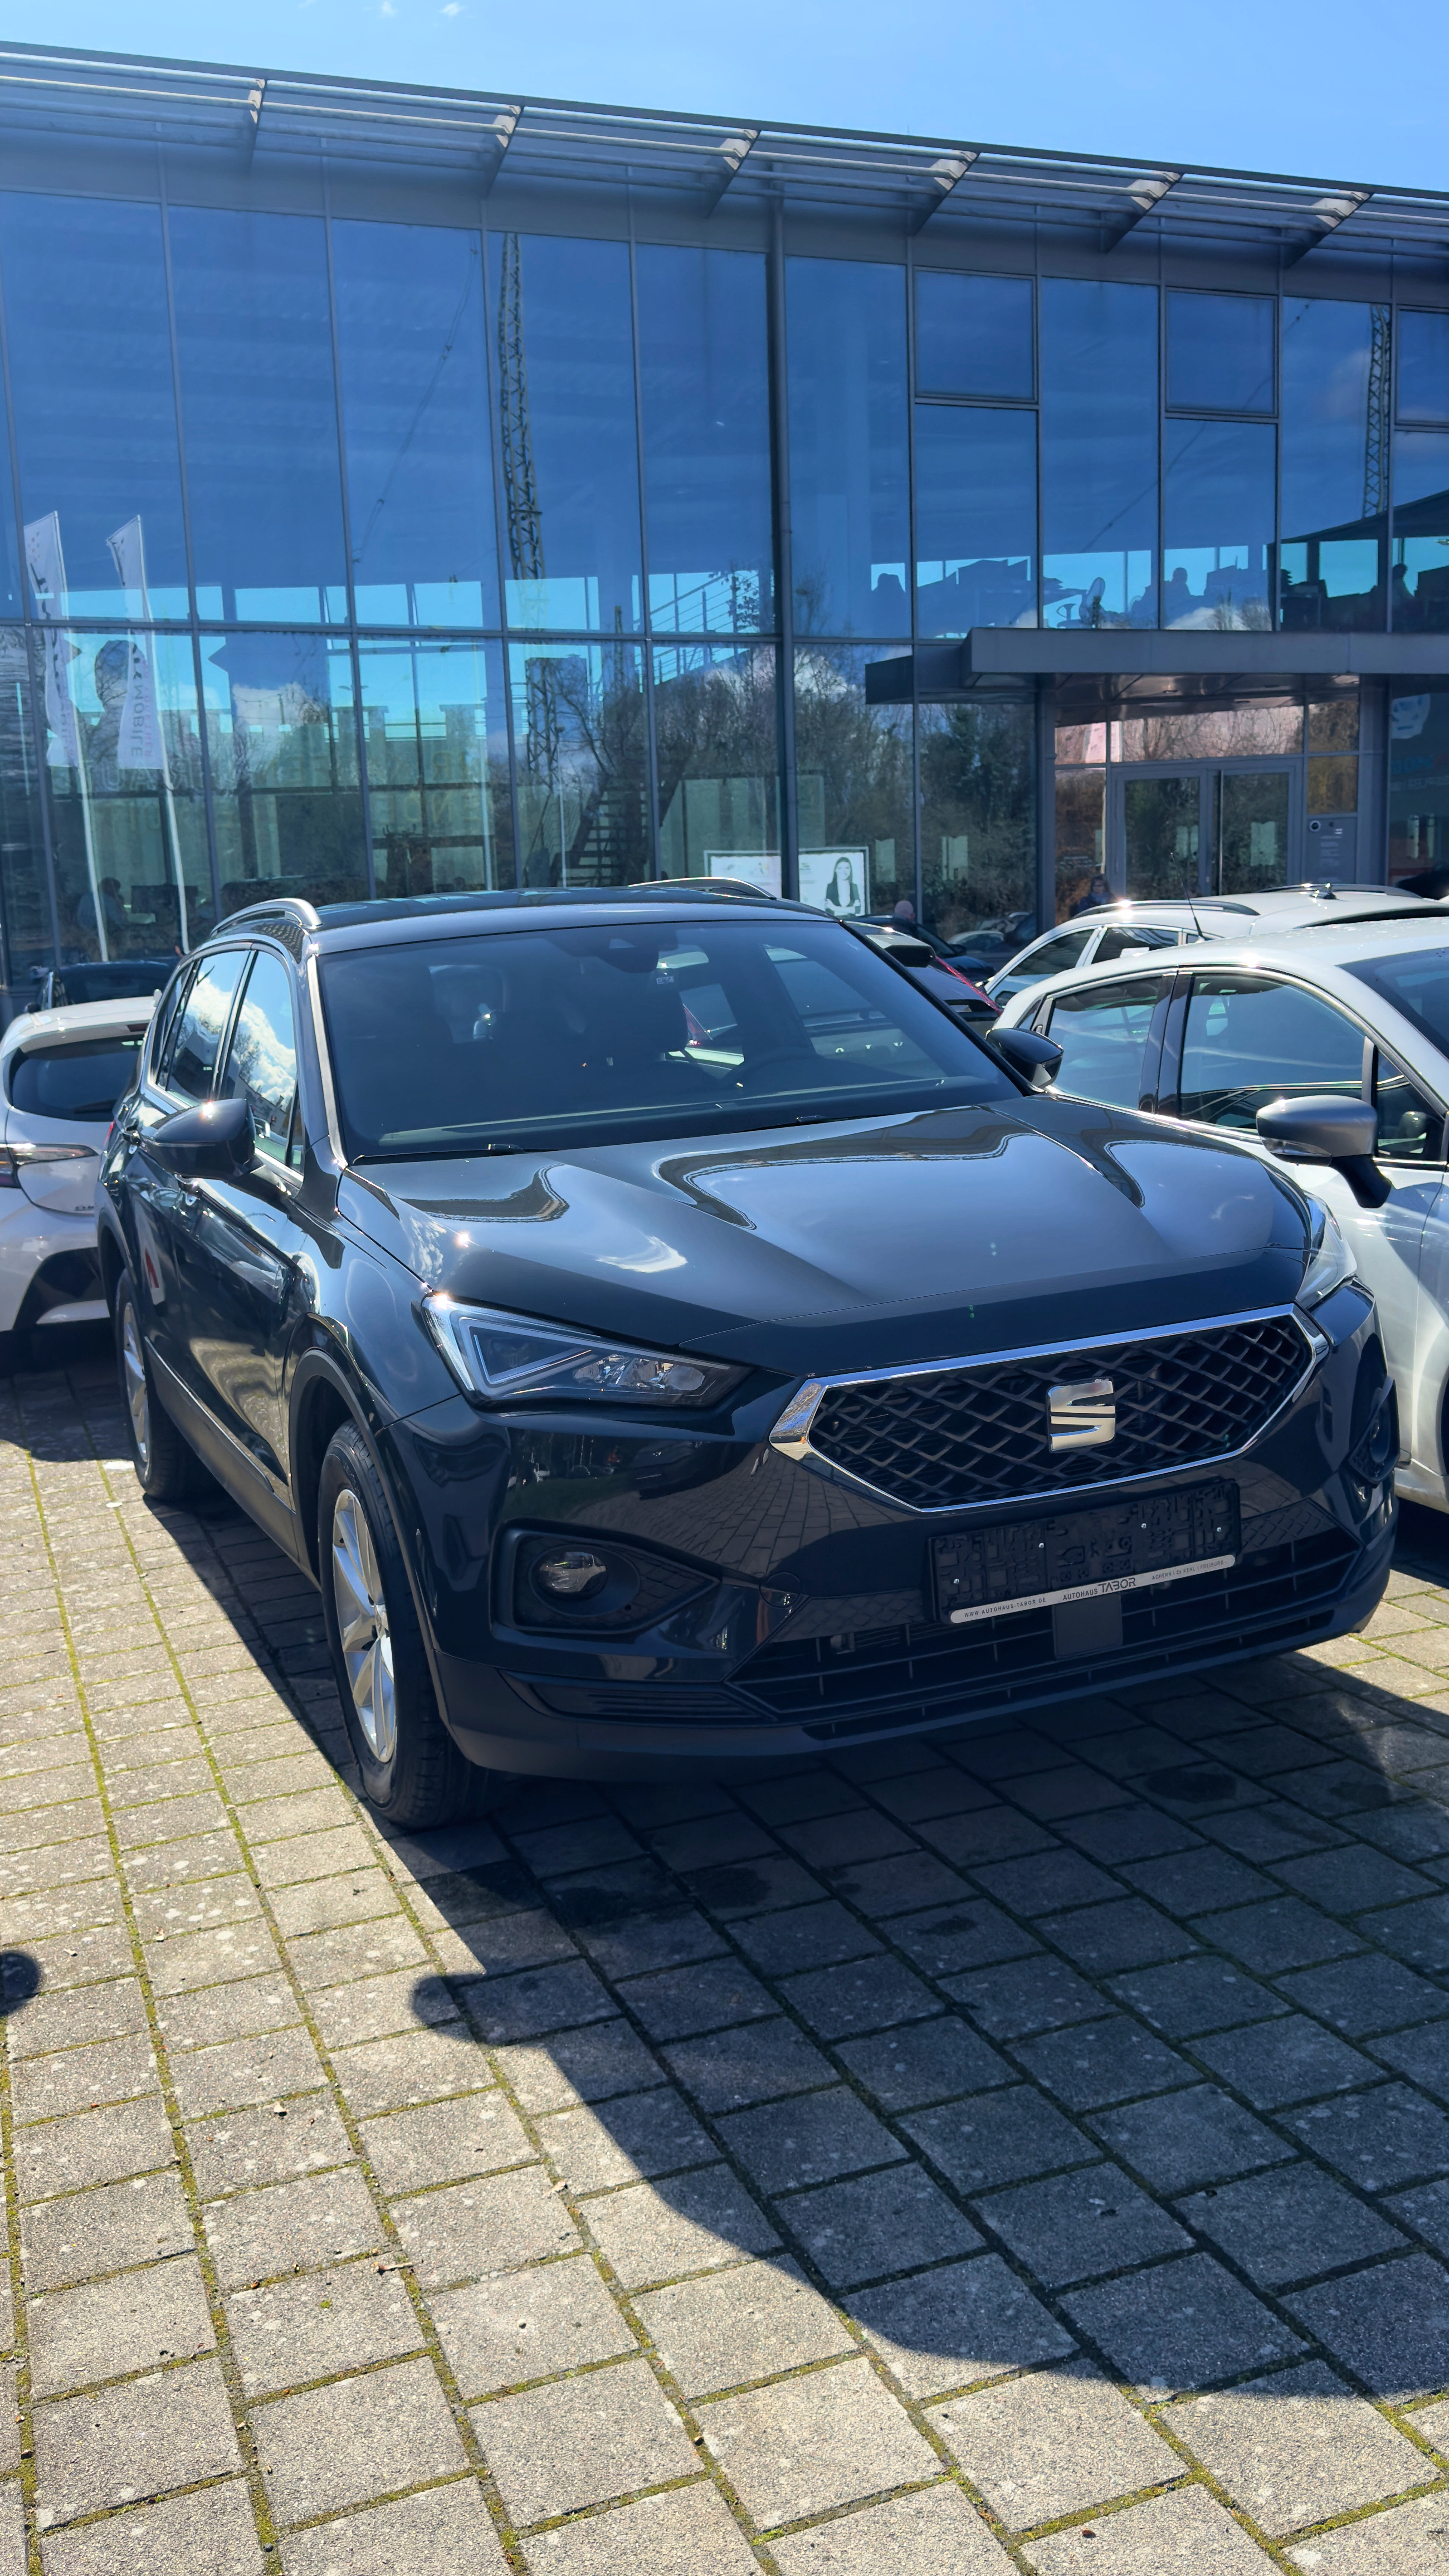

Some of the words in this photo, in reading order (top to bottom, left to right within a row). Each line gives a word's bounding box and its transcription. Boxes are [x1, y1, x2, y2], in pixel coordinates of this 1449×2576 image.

[1063, 1588, 1098, 1600] AUTOHAUS
[1098, 1577, 1136, 1593] TABOR
[964, 1597, 1046, 1617] WWWAUTOHAUS-TABORDE
